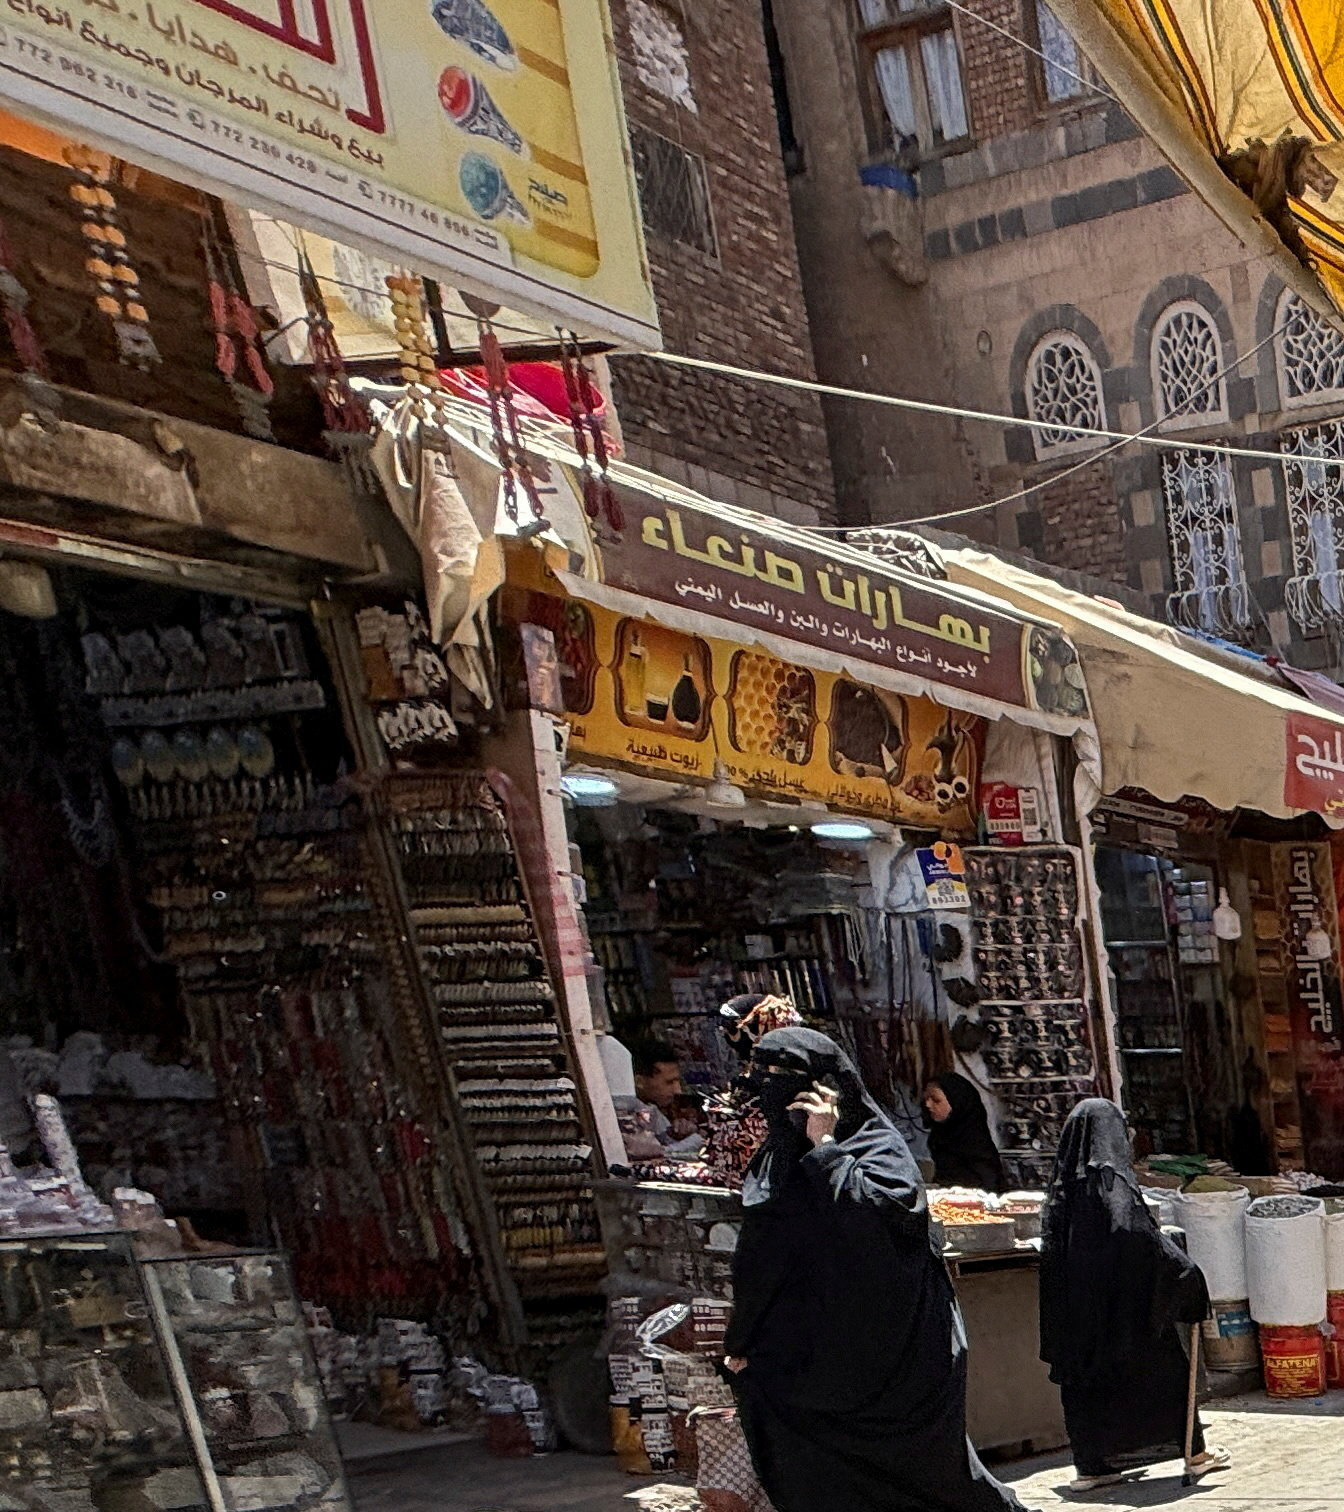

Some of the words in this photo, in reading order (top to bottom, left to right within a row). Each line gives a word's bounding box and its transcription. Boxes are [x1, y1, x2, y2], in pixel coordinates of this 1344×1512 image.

[80, 19, 172, 77] وجميع
[146, 2, 239, 67] هدايا
[175, 62, 269, 116] المرجان
[275, 110, 344, 151] وشراء
[348, 138, 386, 169] بيع
[641, 507, 806, 595] صنعاء
[673, 575, 723, 602] اليمني
[728, 589, 785, 624] والعسل
[816, 562, 992, 665] بهارات
[831, 620, 892, 653] البهارات
[1295, 954, 1334, 1034] الخليج
